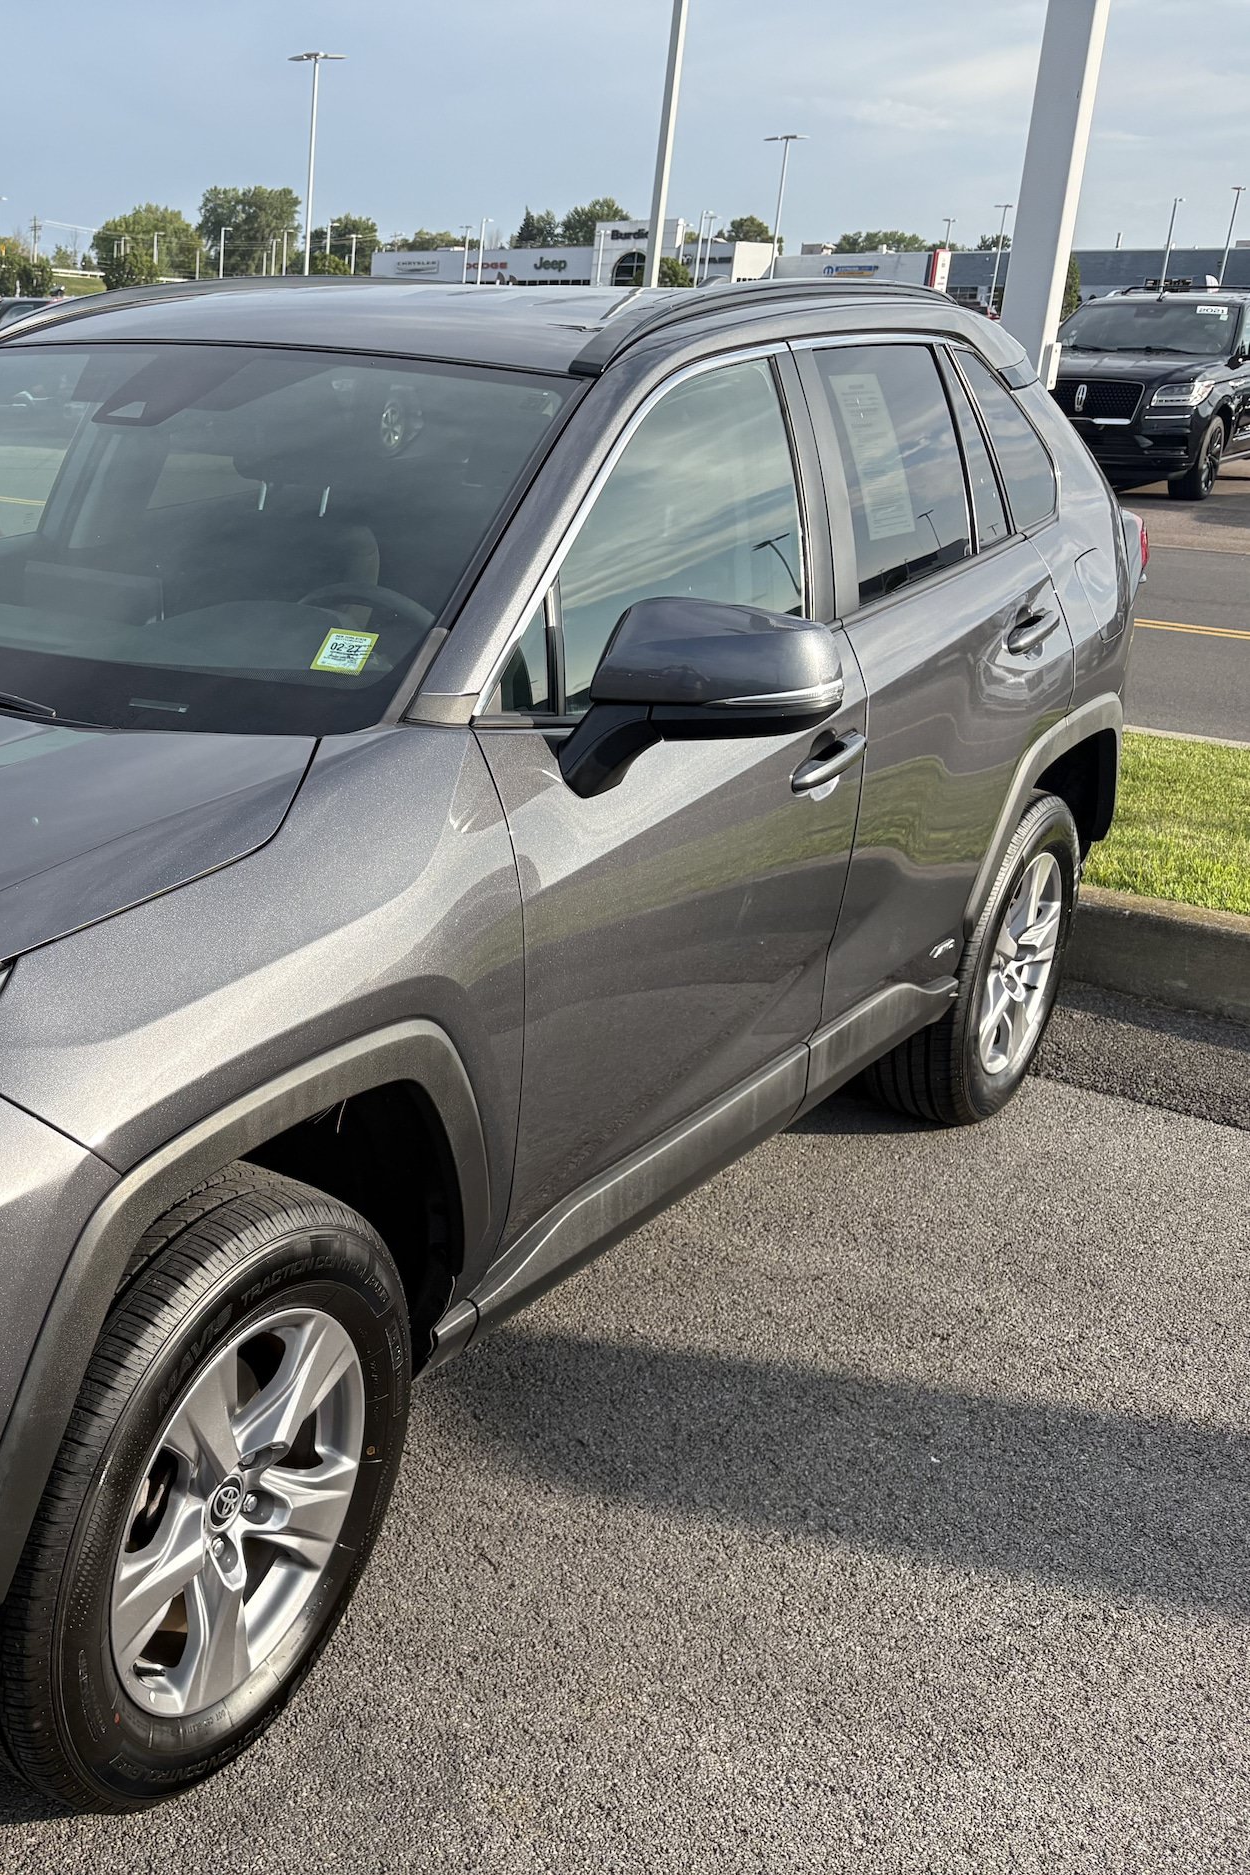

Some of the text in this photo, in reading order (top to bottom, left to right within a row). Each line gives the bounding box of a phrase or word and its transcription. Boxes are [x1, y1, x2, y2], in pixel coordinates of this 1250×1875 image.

[611, 228, 649, 240] Burdic
[465, 262, 508, 270] DODGE
[534, 256, 567, 272] Jeep
